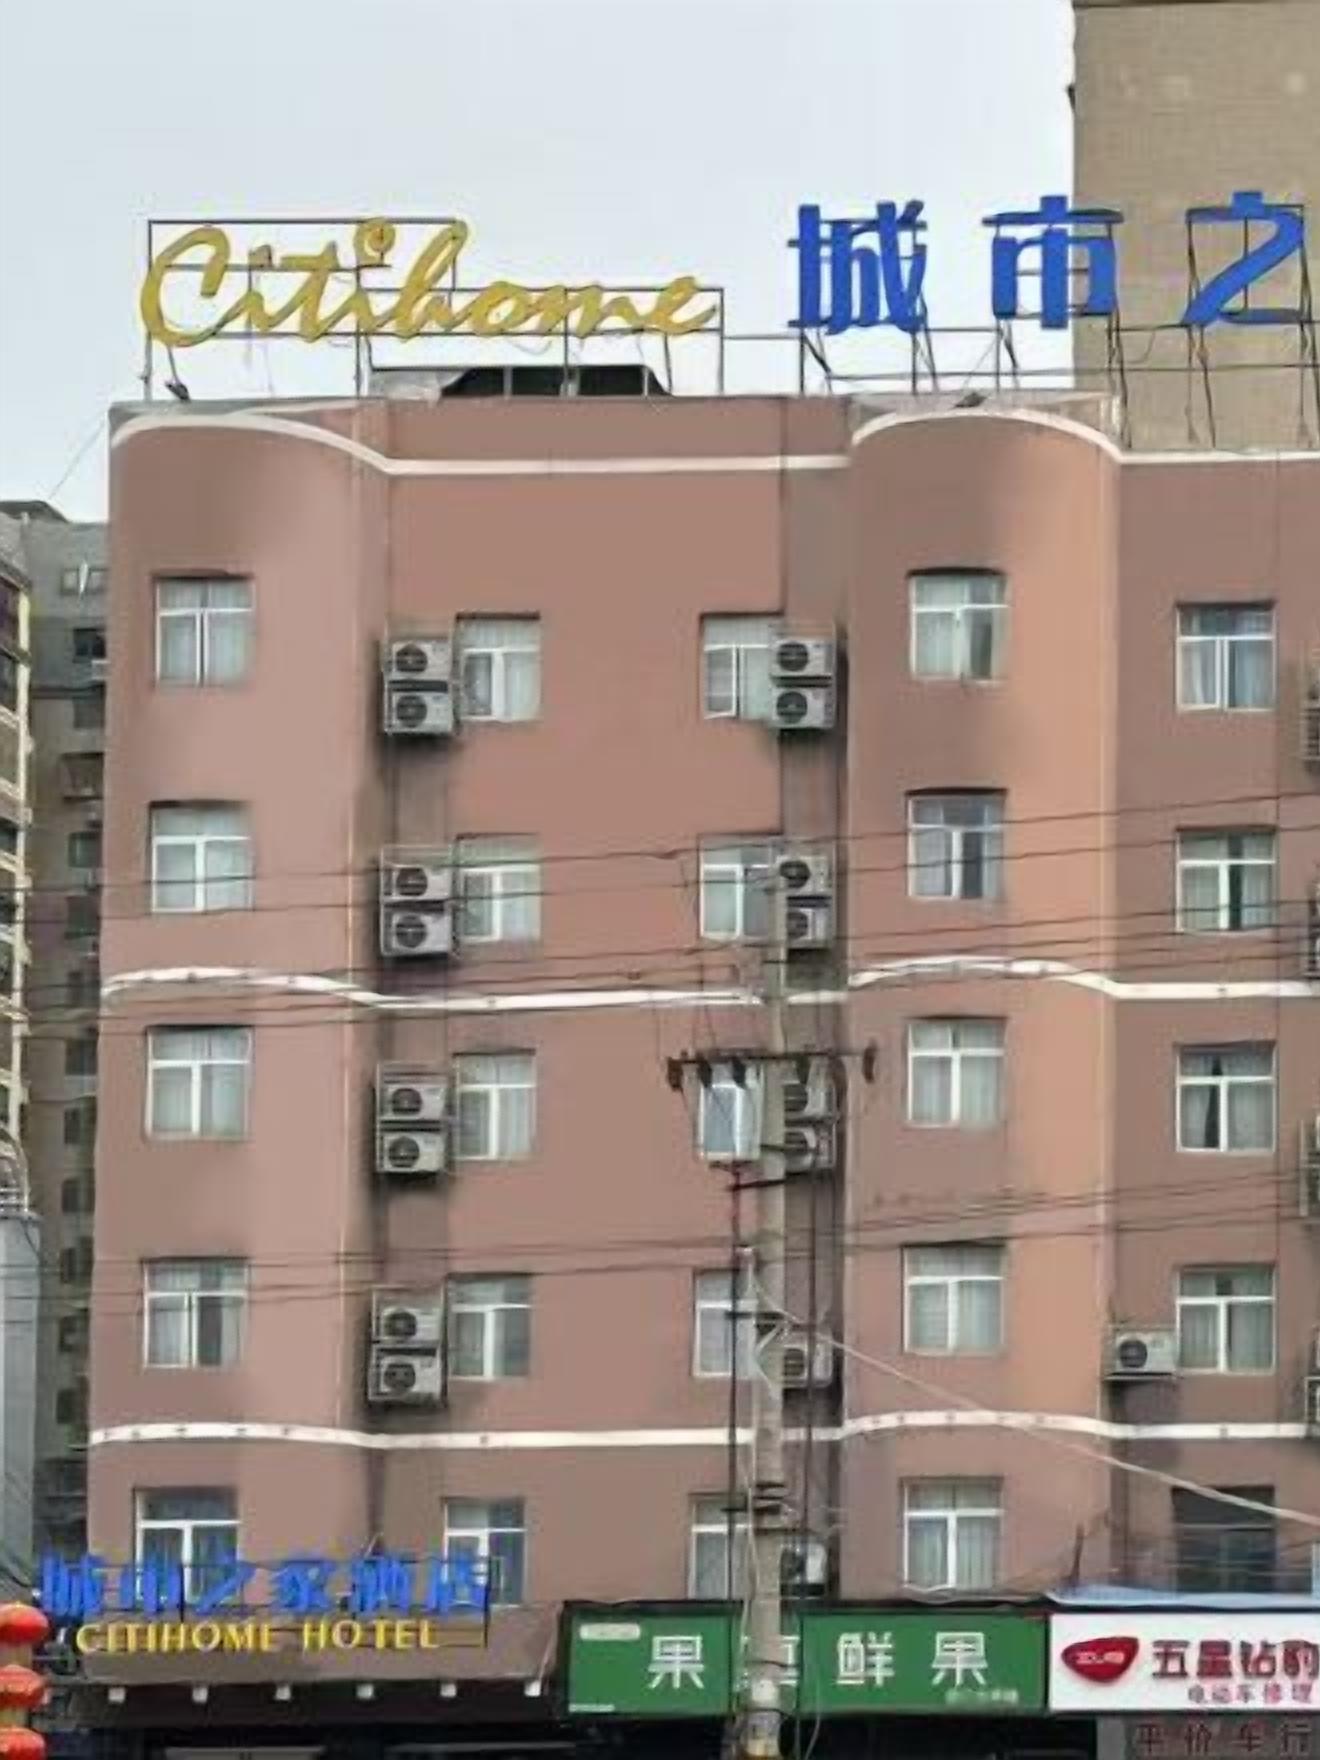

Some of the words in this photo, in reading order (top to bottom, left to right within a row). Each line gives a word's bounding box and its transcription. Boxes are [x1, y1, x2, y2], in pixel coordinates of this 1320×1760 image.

[140, 216, 716, 347] Citihome
[76, 1620, 281, 1654] CITIHOME
[301, 1618, 441, 1651] HOTEL
